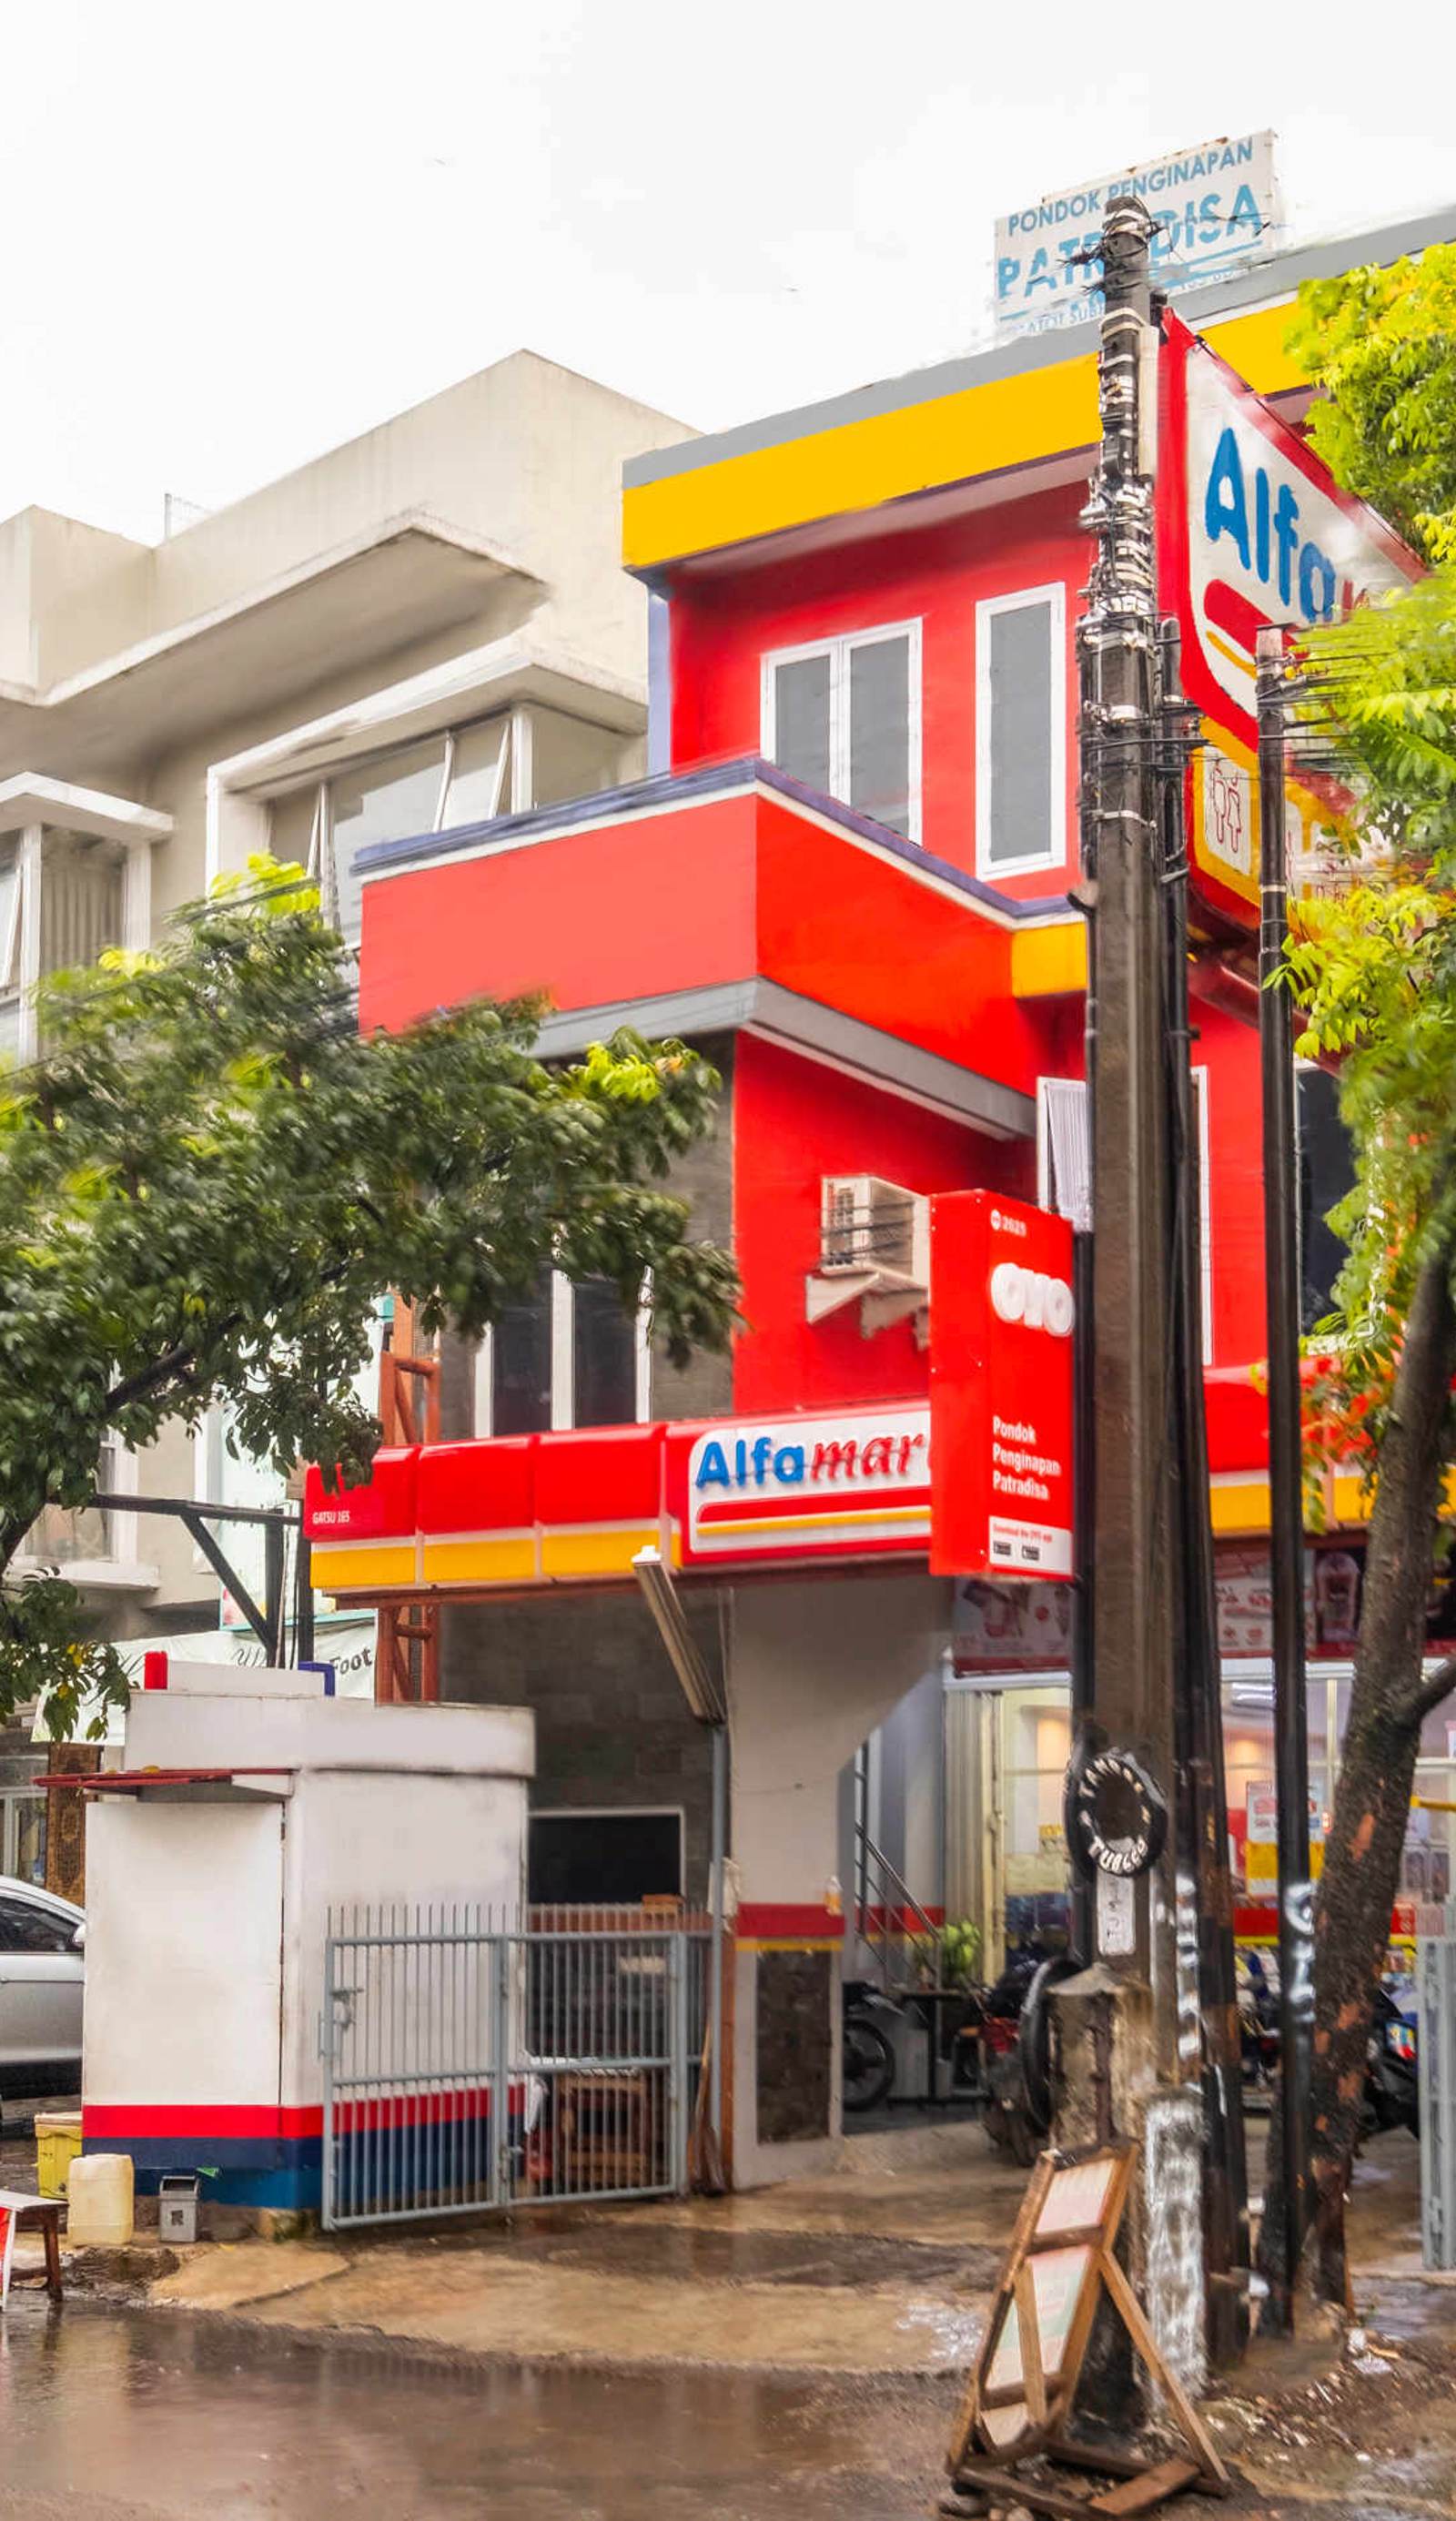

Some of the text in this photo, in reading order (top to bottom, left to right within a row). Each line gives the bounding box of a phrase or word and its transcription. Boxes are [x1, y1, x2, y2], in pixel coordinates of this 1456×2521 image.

[1008, 137, 1253, 237] PONDOK PENGINAPAN
[996, 184, 1263, 300] PATRDISA
[1205, 427, 1370, 623] Alfa
[990, 1261, 1075, 1336] OYO
[695, 1433, 926, 1490] Alfamar
[993, 1414, 1036, 1445] Pondok
[993, 1442, 1062, 1476] Penginapan
[993, 1469, 1050, 1501] Patradisa
